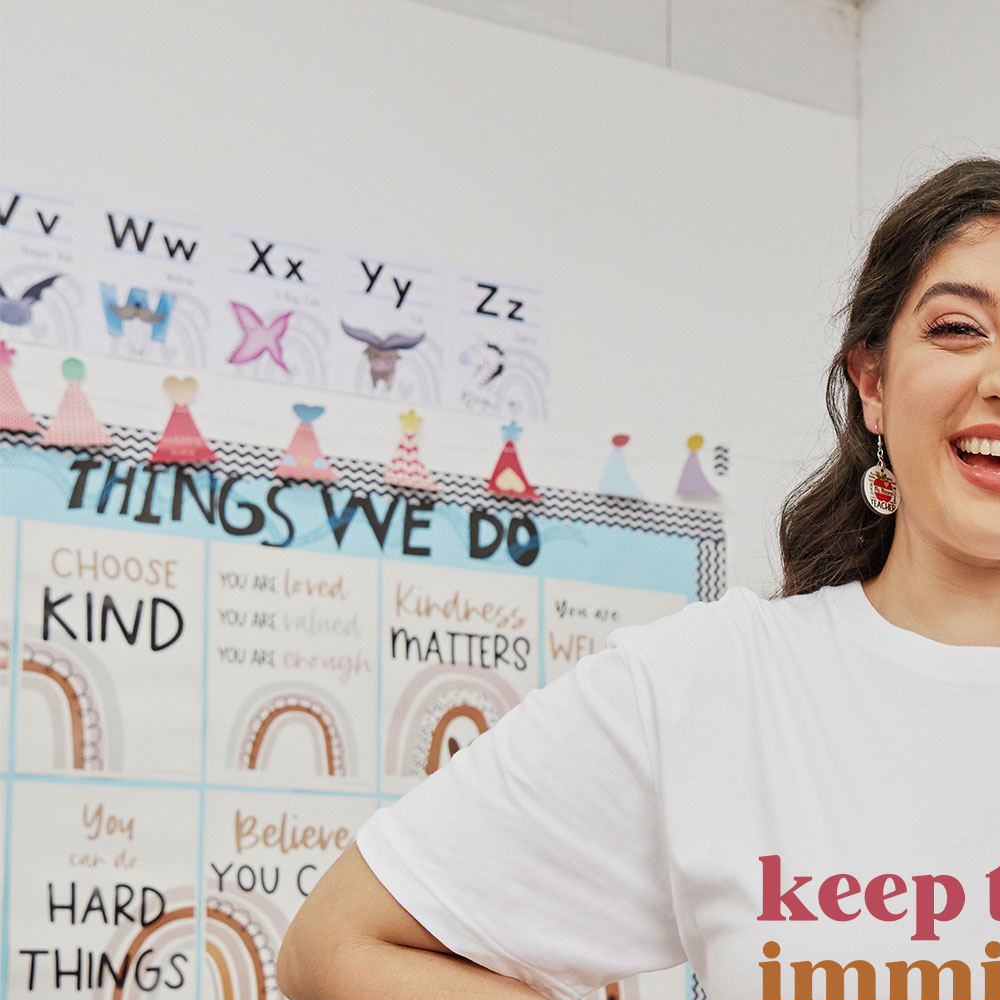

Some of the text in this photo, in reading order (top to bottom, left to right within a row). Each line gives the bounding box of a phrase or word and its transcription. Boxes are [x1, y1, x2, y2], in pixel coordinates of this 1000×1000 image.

[67, 457, 540, 567] THINGS WE DO
[50, 547, 179, 590] CHOOSE
[218, 568, 347, 602] YOU ARE loved
[40, 585, 185, 653] KIND
[218, 608, 248, 628] YOU
[250, 610, 277, 632] ARE
[395, 581, 528, 630] Kindness
[555, 599, 588, 620] You
[218, 646, 248, 665] YOU
[250, 648, 276, 669] ARE
[83, 803, 135, 841] You
[235, 809, 350, 854] Believe
[68, 851, 105, 868] can
[210, 862, 280, 895] YOU
[48, 881, 167, 928] HARD
[757, 855, 966, 941] keep
[19, 948, 190, 993] THINGS
